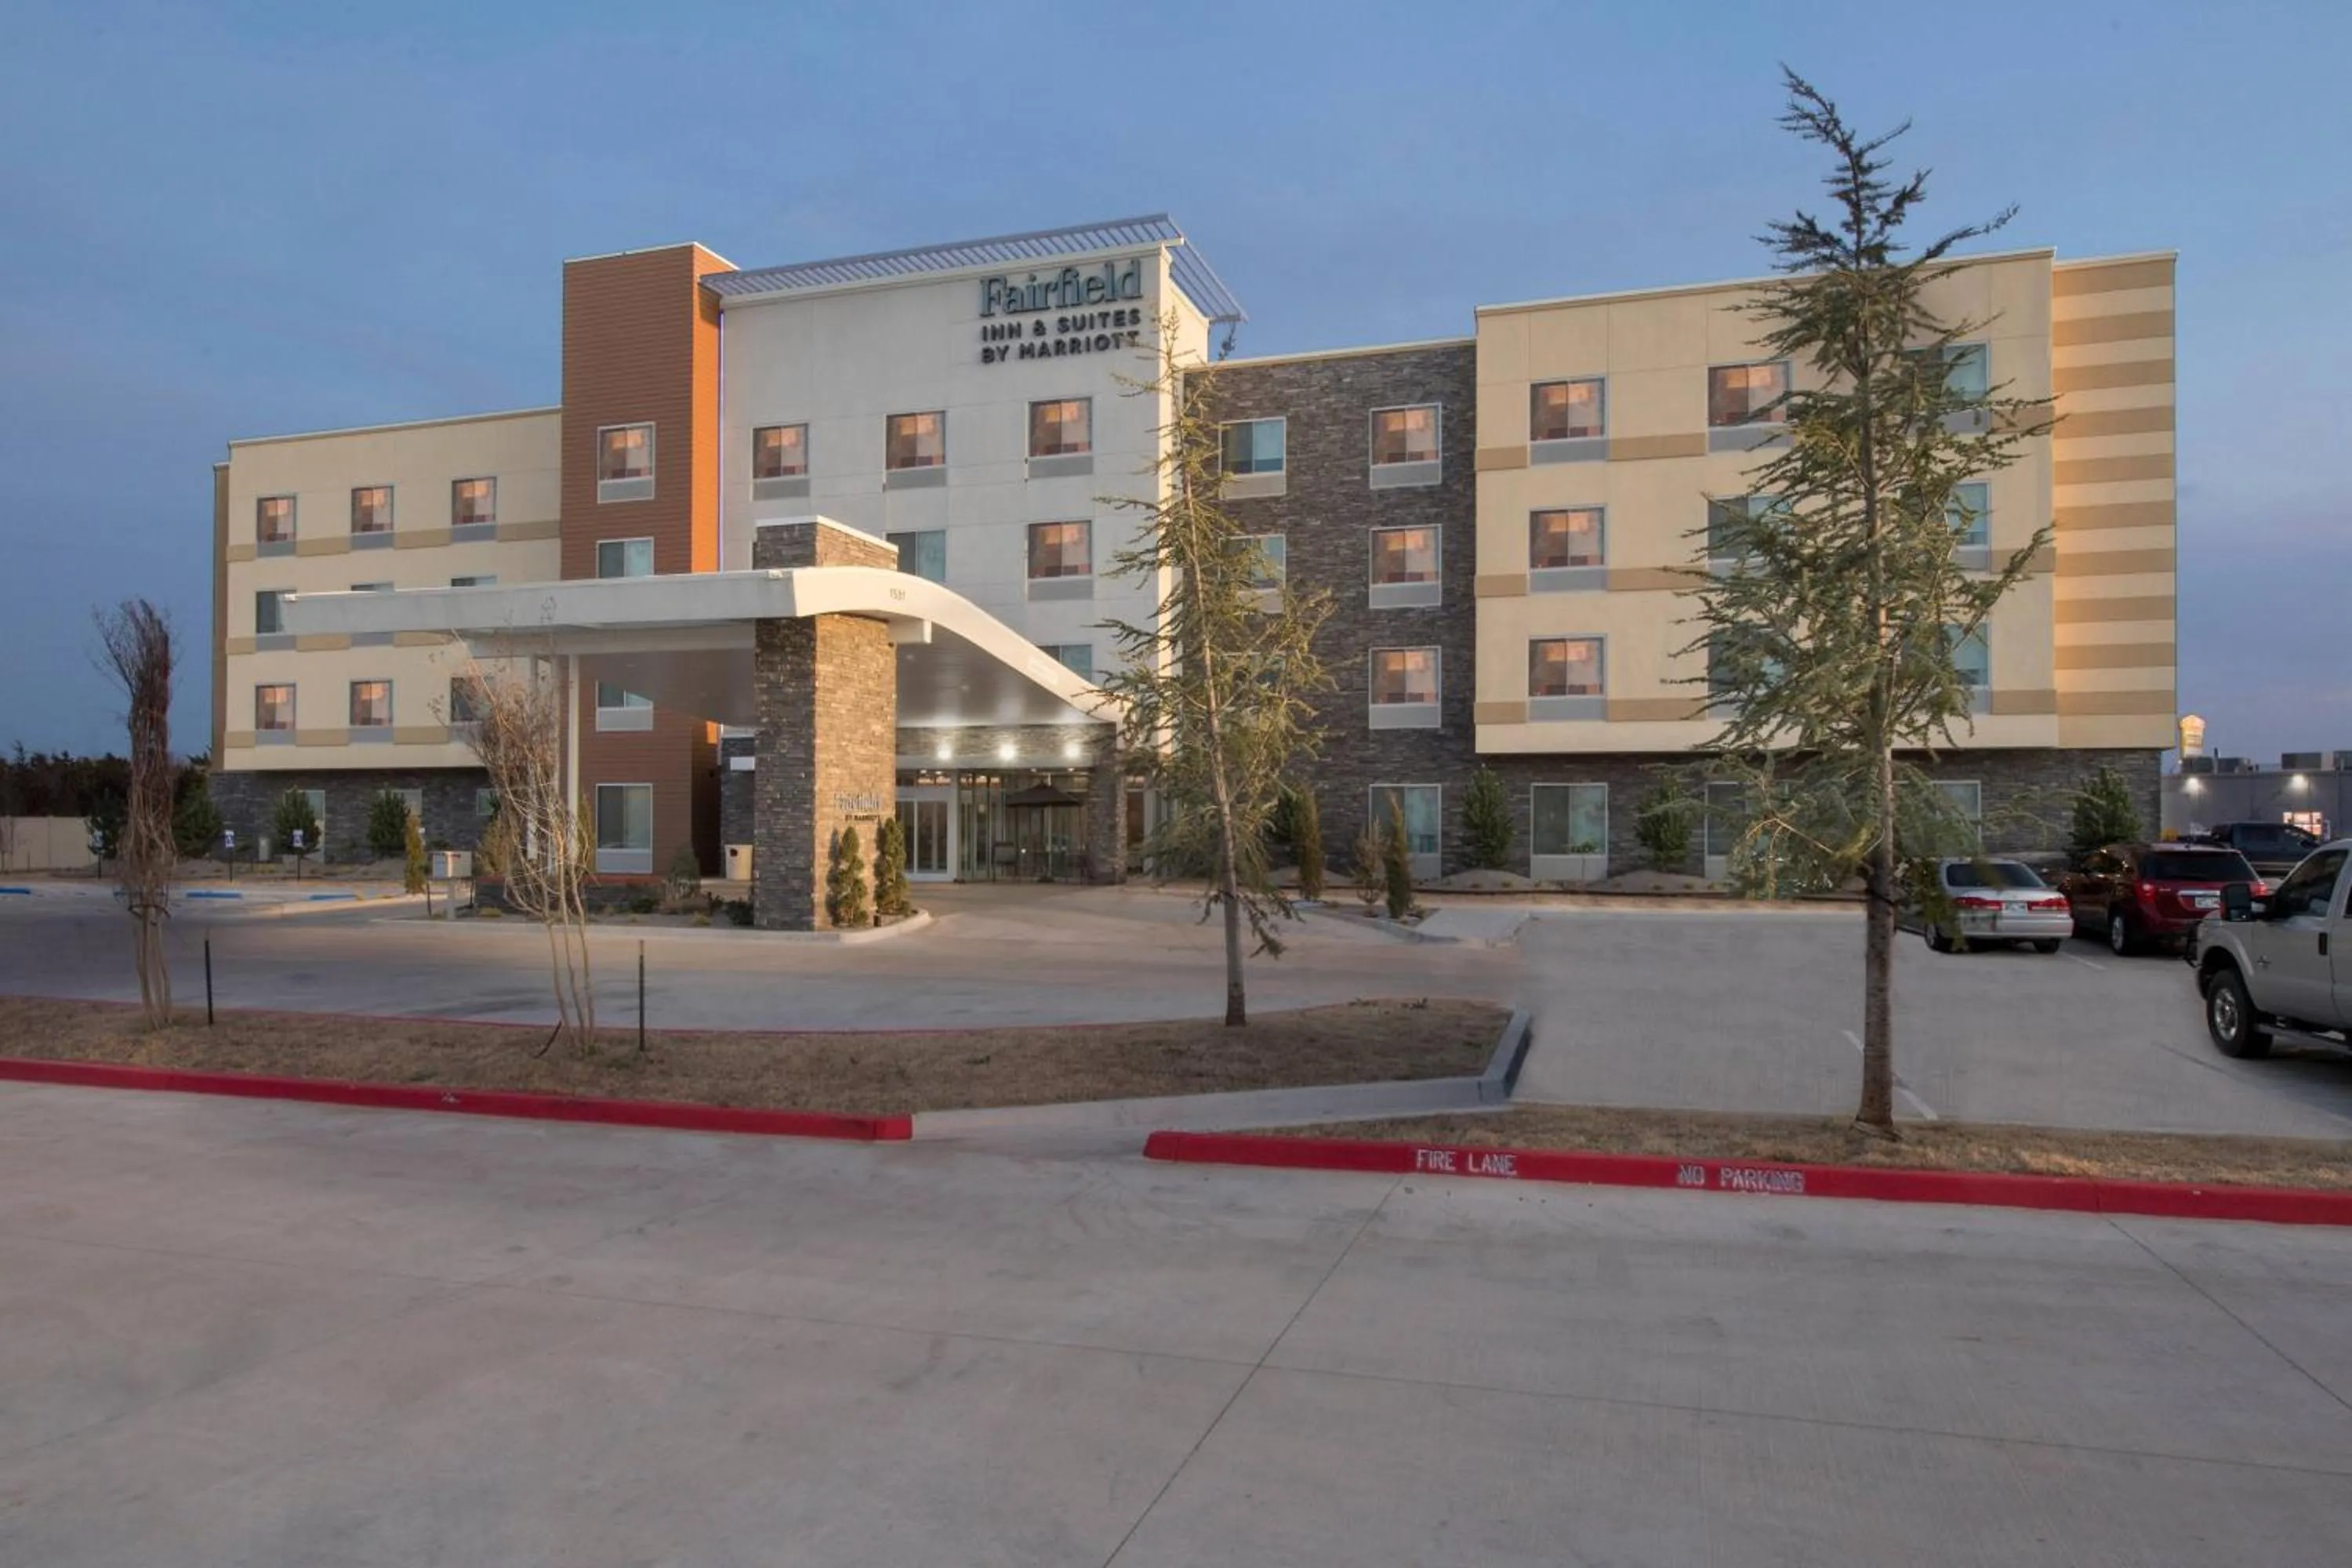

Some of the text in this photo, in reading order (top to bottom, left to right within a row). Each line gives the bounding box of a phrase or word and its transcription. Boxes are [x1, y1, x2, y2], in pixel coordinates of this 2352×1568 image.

[979, 258, 1143, 317] Fairfield
[982, 308, 1141, 342] INN & SUITES
[982, 330, 1140, 364] BY MARRIOTT
[1416, 1149, 1518, 1175] FIRE LANE
[1678, 1164, 1804, 1193] NO PARKING
